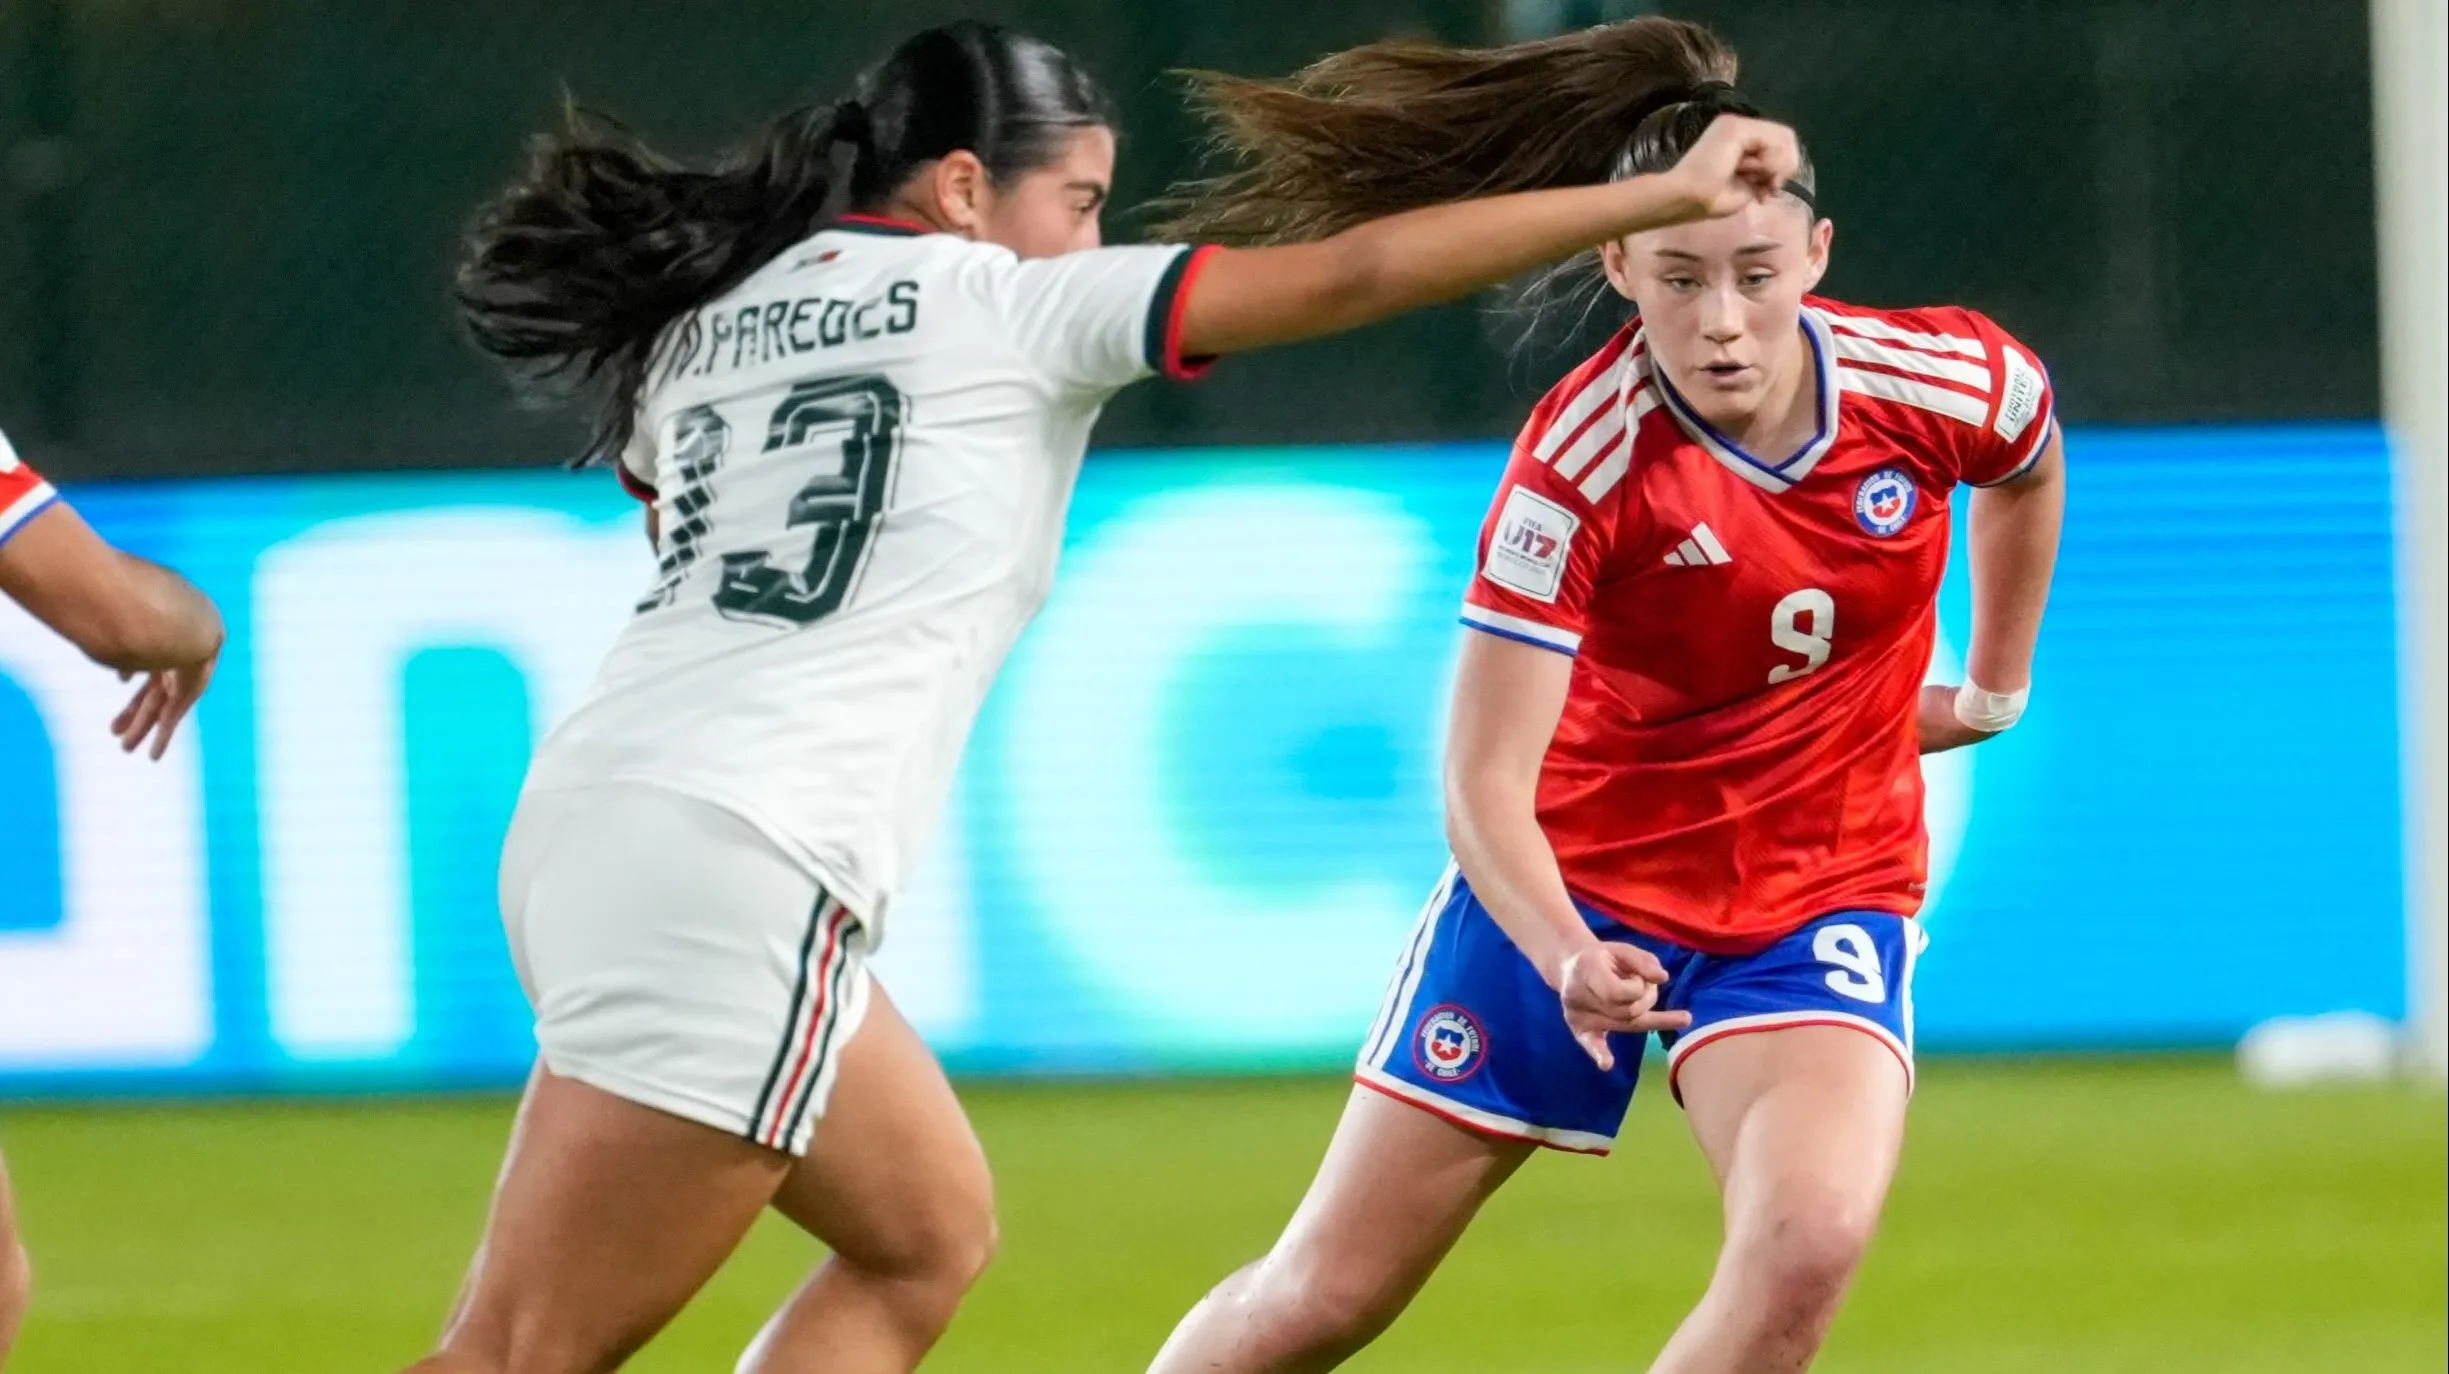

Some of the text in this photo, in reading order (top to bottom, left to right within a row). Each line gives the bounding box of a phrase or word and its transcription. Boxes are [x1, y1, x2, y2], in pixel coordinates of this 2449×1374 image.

[635, 372, 912, 630] 13
[1503, 520, 1558, 559] U17
[1767, 588, 1835, 685] 9
[1812, 924, 1886, 1004] 9
